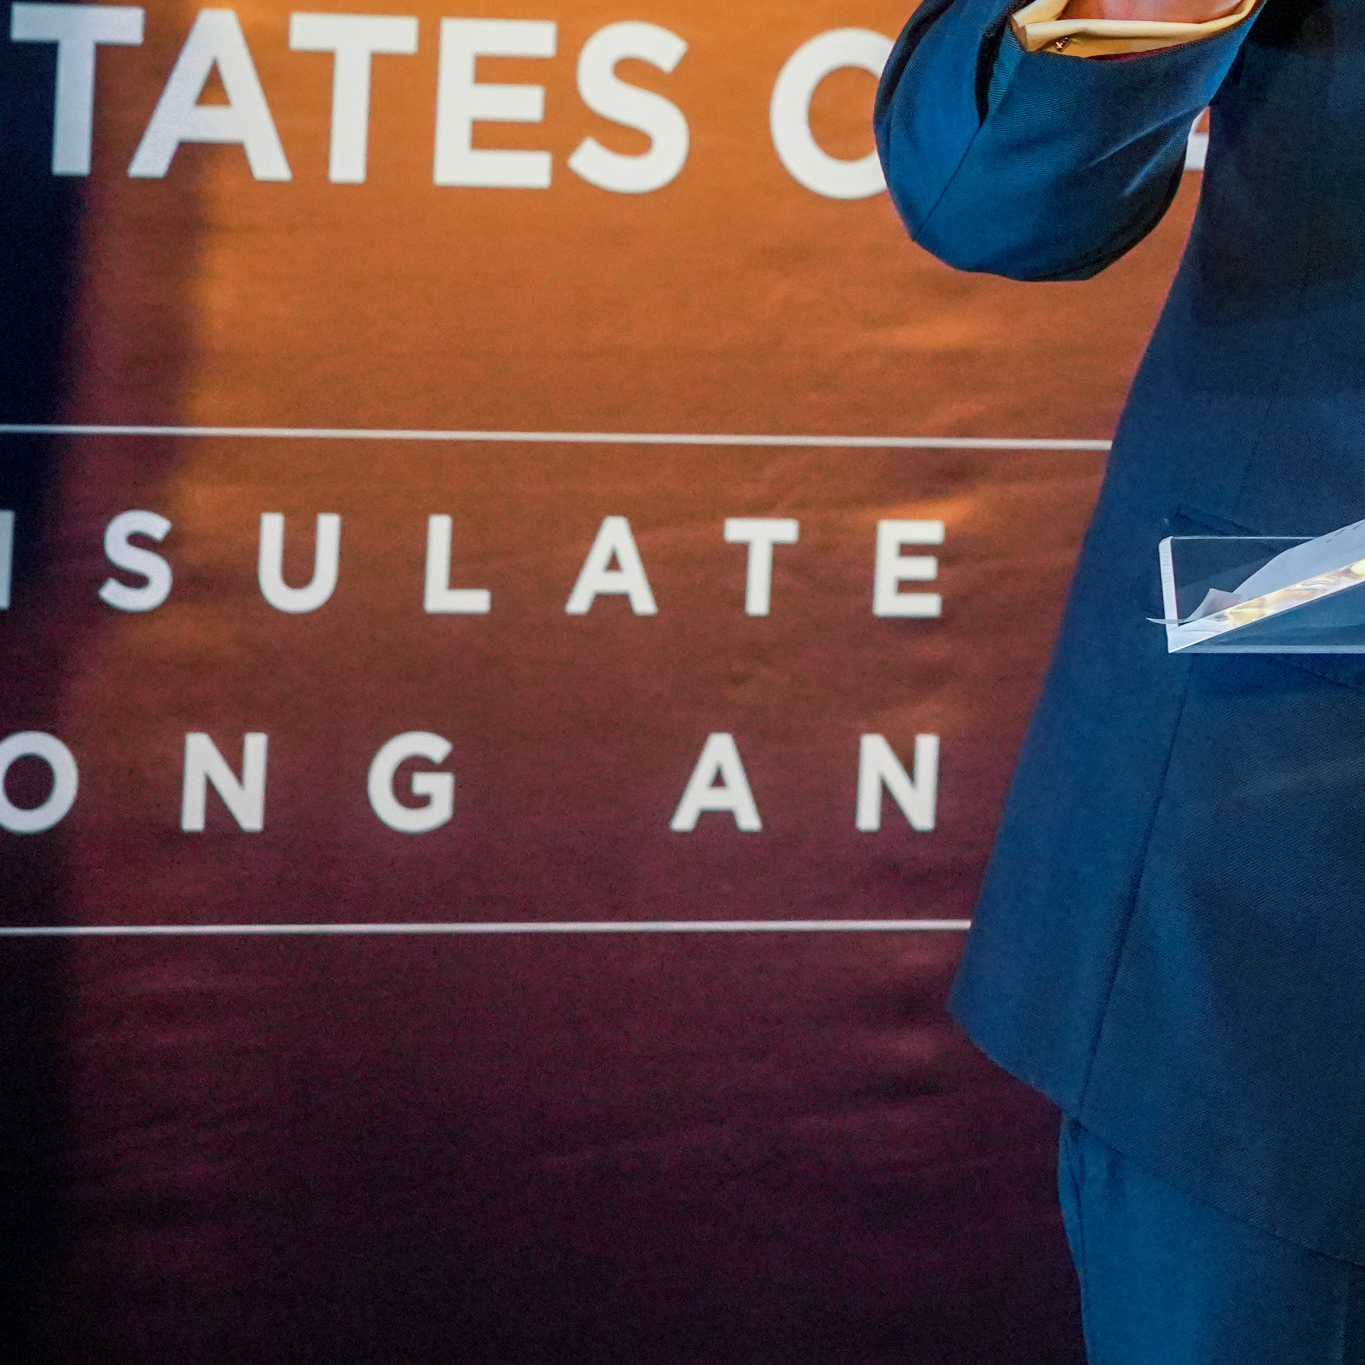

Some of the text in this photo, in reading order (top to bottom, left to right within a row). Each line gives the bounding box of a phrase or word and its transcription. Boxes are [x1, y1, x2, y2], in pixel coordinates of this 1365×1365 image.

[10, 2, 691, 195] TATES
[0, 730, 941, 834] ONG AN
